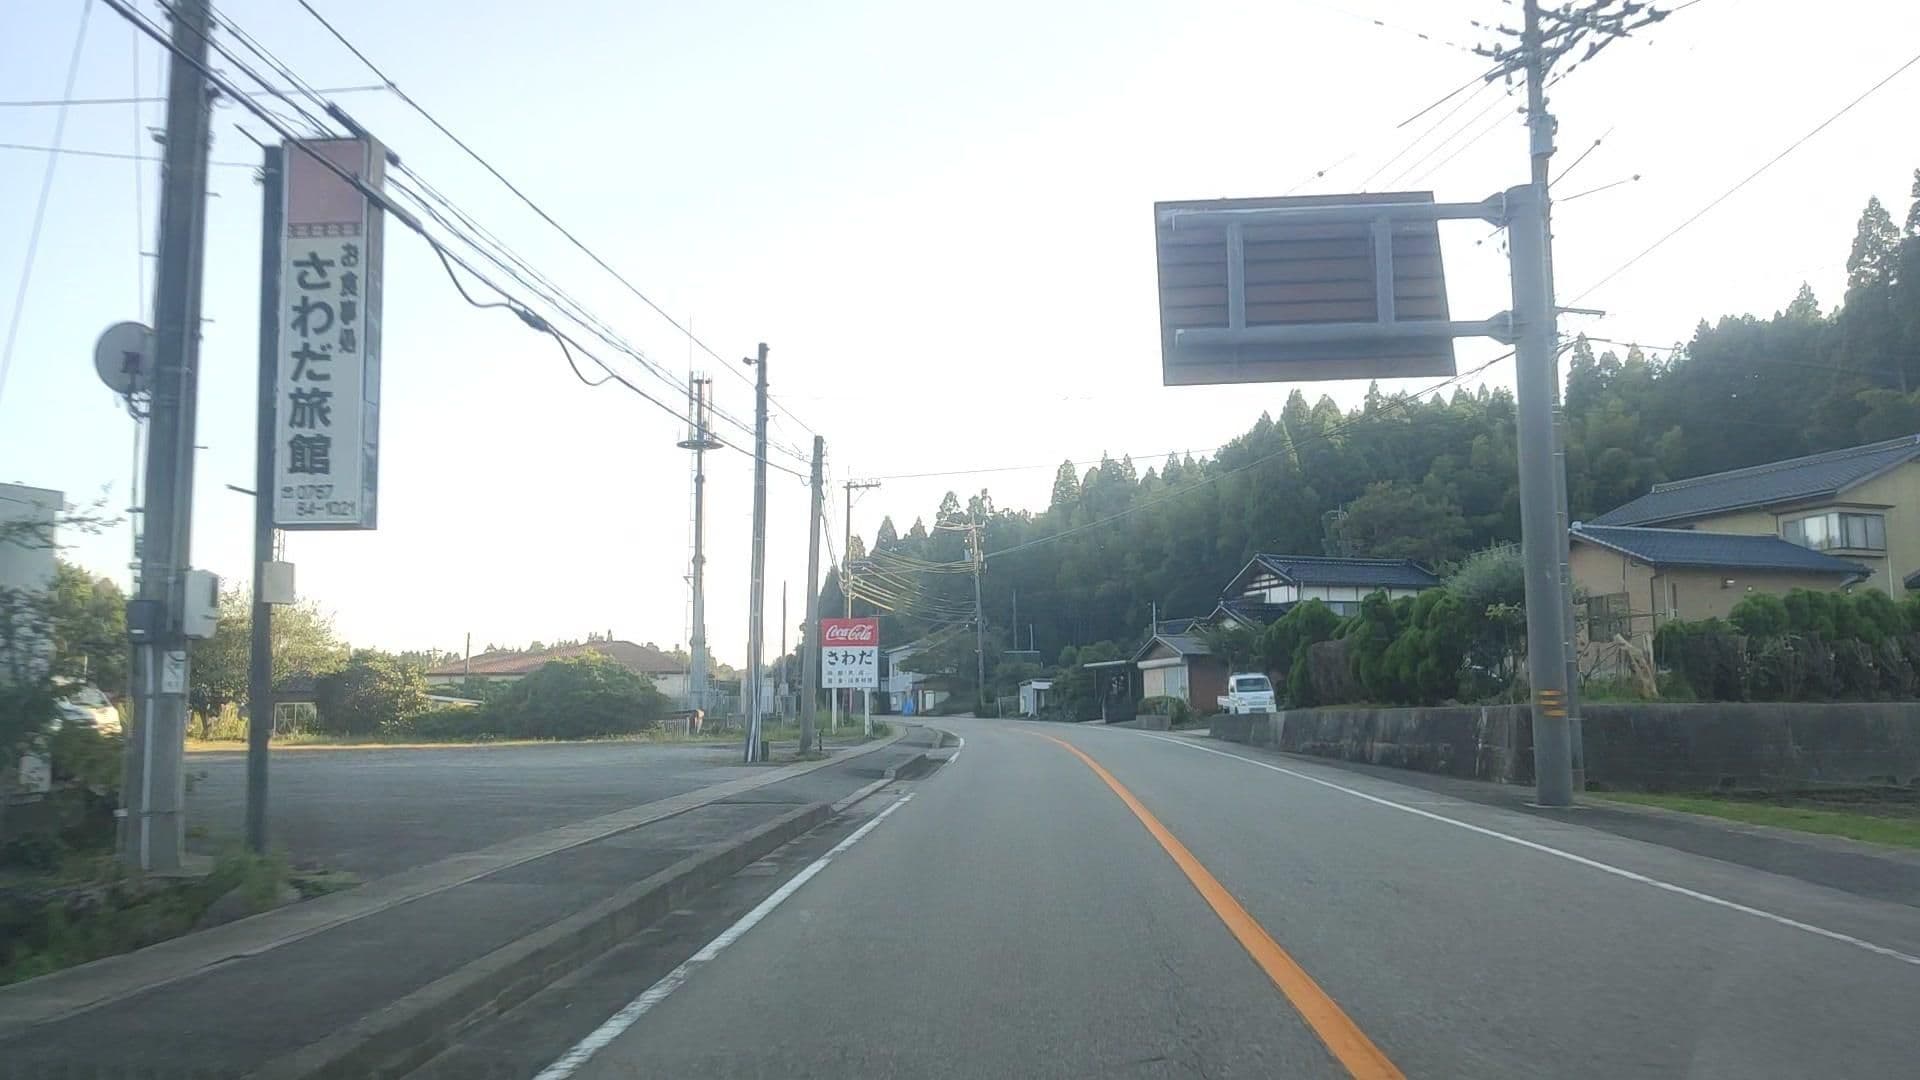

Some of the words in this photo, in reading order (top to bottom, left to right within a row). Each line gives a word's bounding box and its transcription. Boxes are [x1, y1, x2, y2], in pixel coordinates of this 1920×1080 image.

[287, 251, 335, 475] さわだ旅館
[827, 650, 873, 666] さわだ
